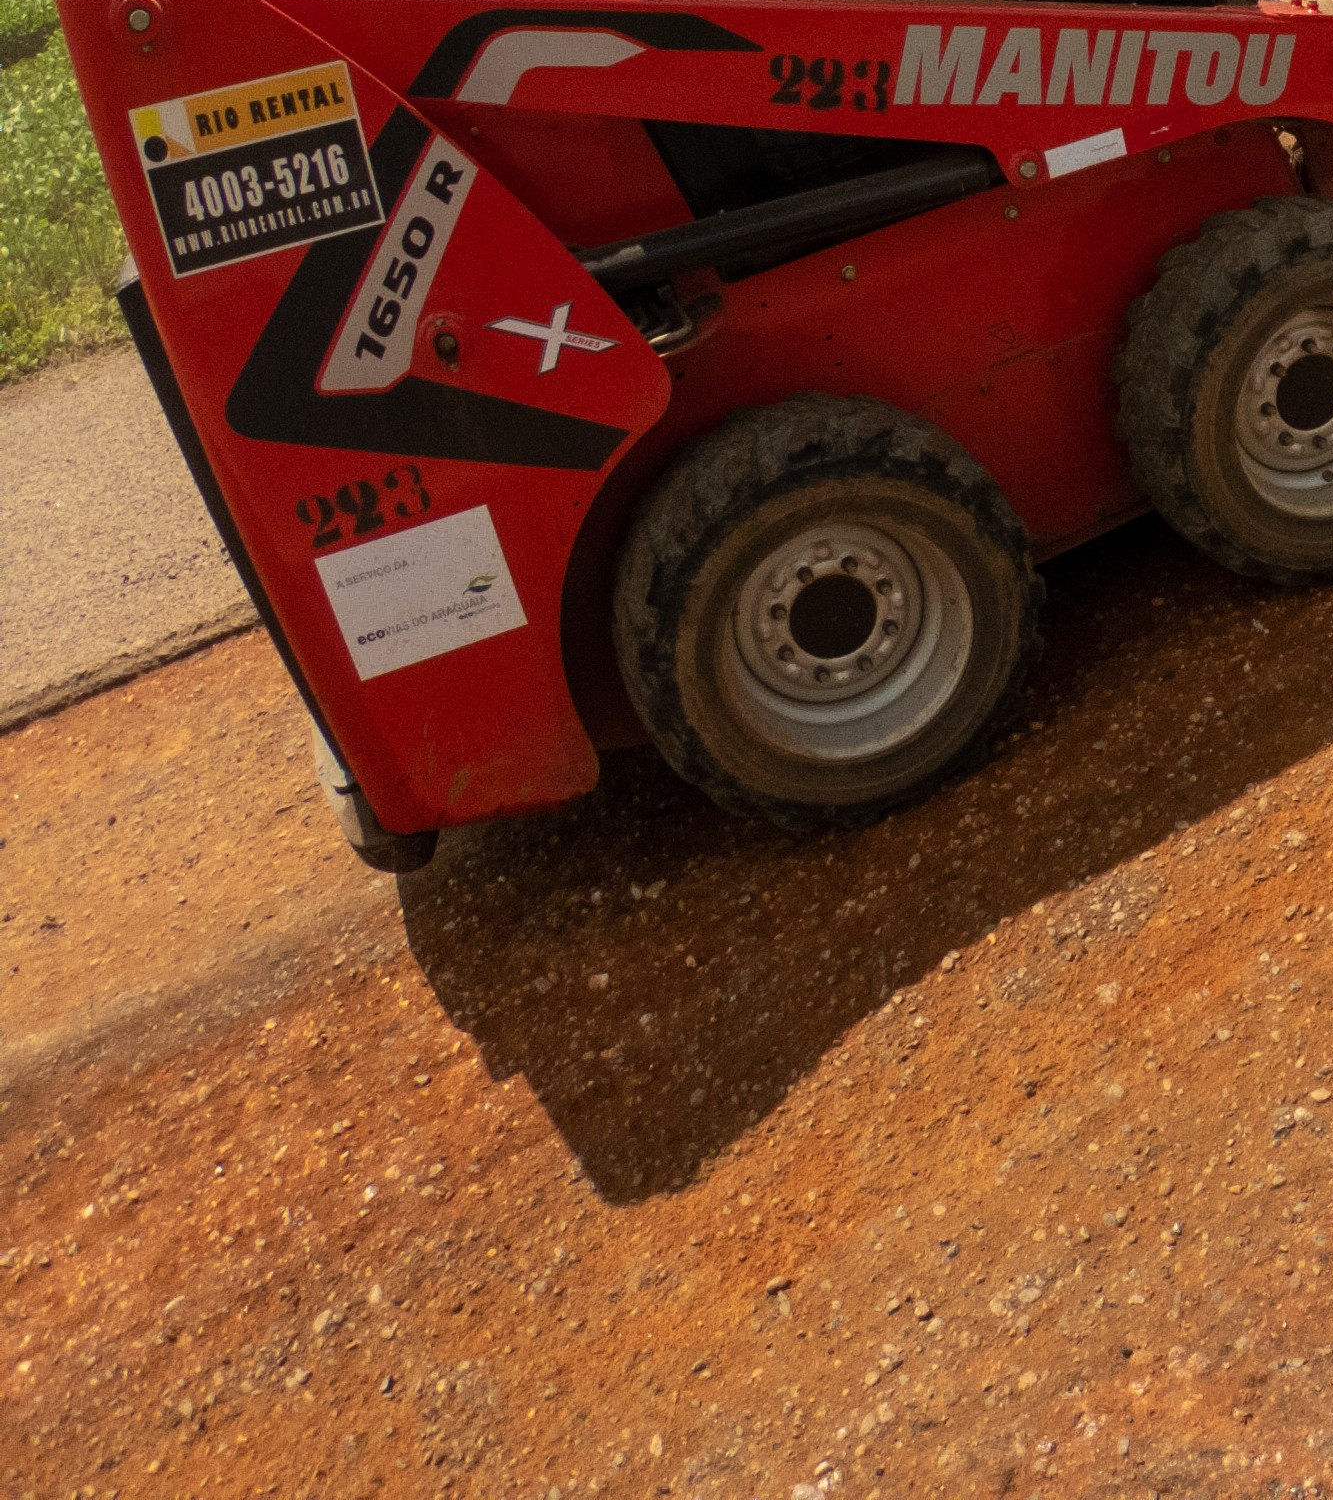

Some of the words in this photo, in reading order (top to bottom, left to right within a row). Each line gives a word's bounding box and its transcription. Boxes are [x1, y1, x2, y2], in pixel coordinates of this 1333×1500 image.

[769, 53, 891, 114] 223
[893, 24, 1297, 106] MANITOU
[195, 106, 239, 137] RIO
[249, 82, 344, 124] RENTAL
[184, 144, 349, 221] 4003-5216
[173, 188, 372, 256] WWW.RIORENTAL.COM.BR
[355, 215, 435, 360] 1650
[425, 160, 464, 205] R
[484, 300, 621, 376] X
[566, 334, 600, 349] SERIES
[295, 464, 431, 549] 223
[336, 580, 345, 590] A
[393, 559, 409, 571] DA
[412, 614, 428, 627] DO
[432, 594, 488, 621] ARAGUAIA
